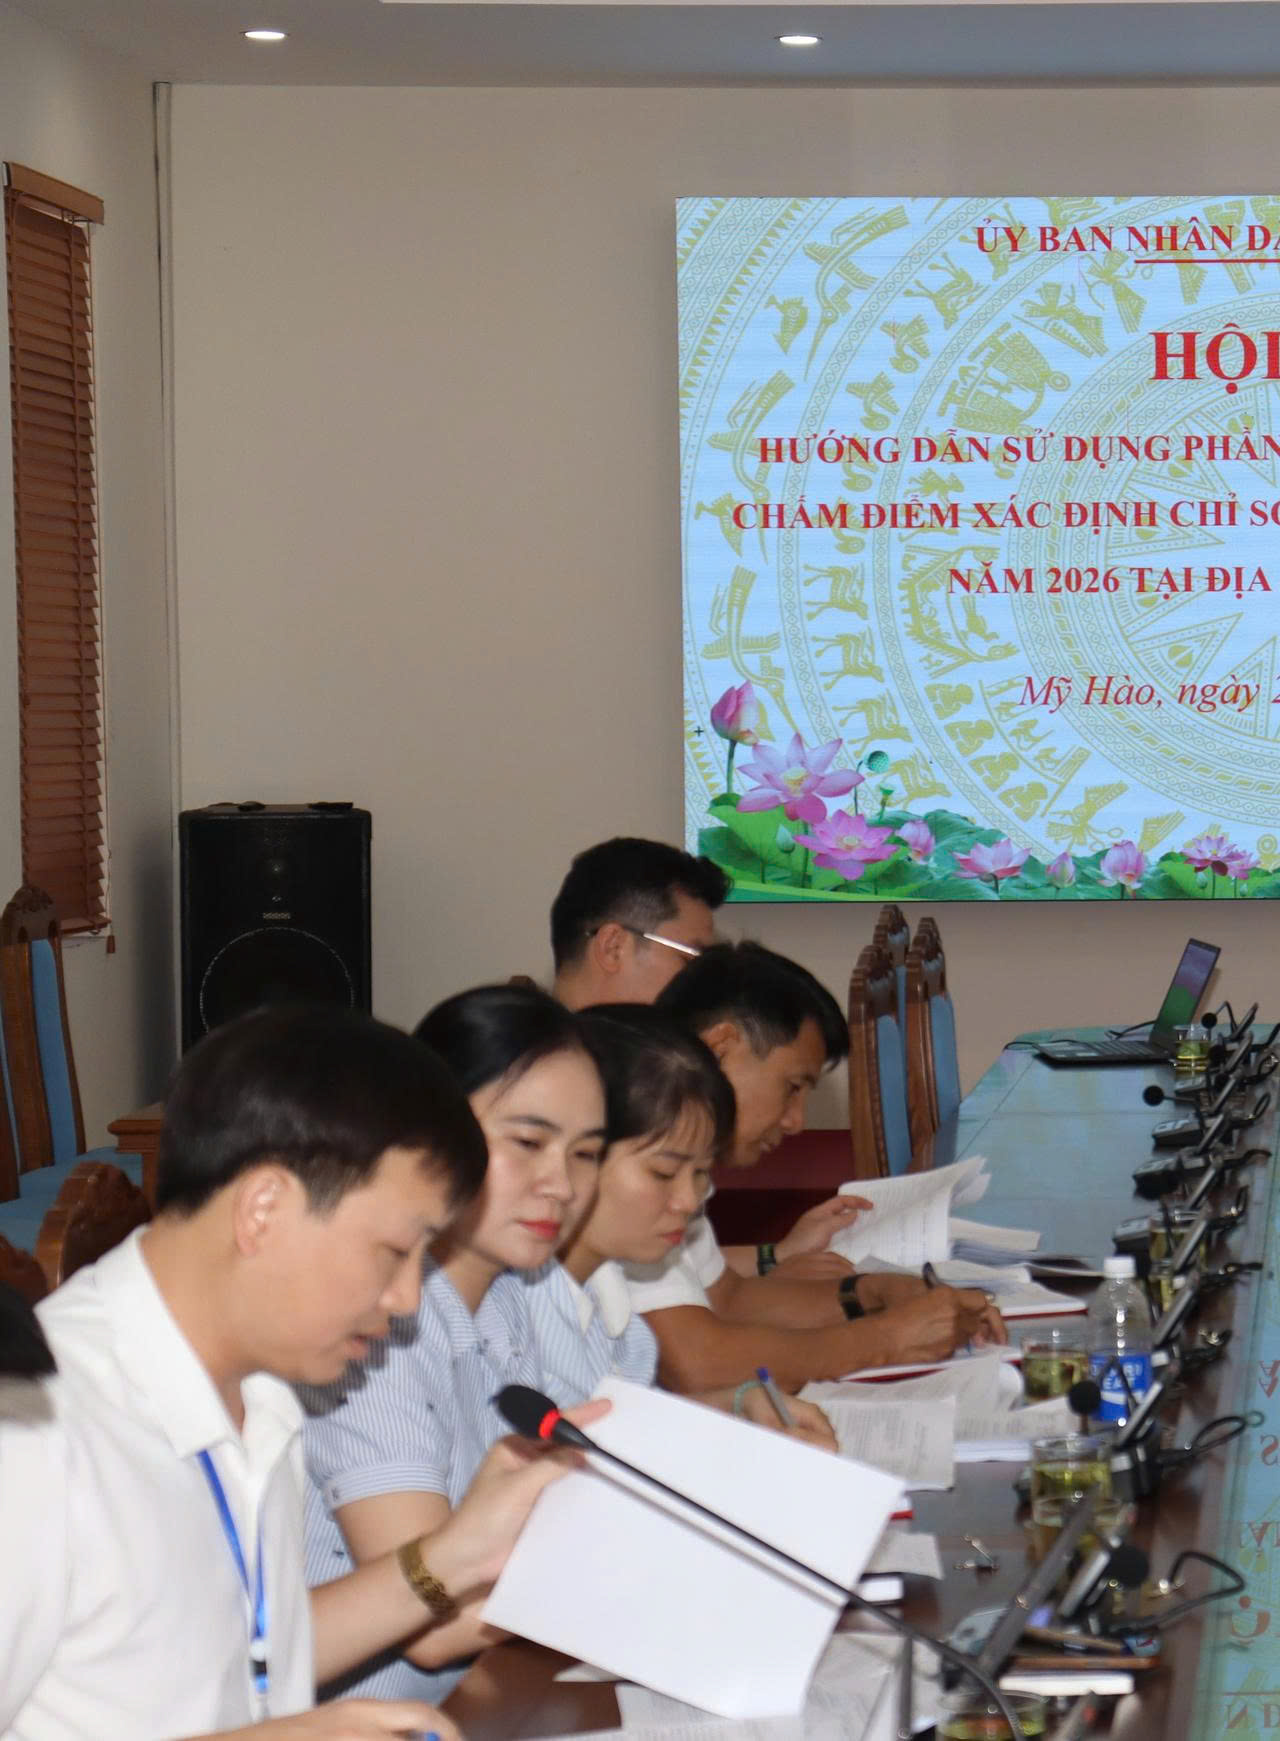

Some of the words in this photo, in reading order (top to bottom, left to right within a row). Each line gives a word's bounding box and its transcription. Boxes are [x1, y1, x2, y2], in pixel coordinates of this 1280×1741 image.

[976, 217, 1027, 253] ỦY
[1038, 225, 1113, 252] BAN
[1127, 217, 1233, 252] NHÂN
[759, 430, 900, 465] HƯỚNG
[911, 427, 991, 463] DẪN
[1002, 427, 1055, 463] SỬ
[1063, 432, 1170, 470] DỤNG
[732, 494, 849, 529] CHẤM
[972, 494, 1053, 529] XÁC
[1063, 501, 1158, 536] ĐỊNH
[1169, 492, 1239, 528] CHỈ
[948, 561, 1034, 594] NĂM
[1046, 566, 1121, 594] 2026
[1129, 567, 1193, 601] TẠI
[1206, 566, 1271, 601] ĐỊA
[1019, 675, 1073, 714] Mỹ
[1083, 674, 1163, 711] Hào,
[1177, 673, 1261, 713] ngày
